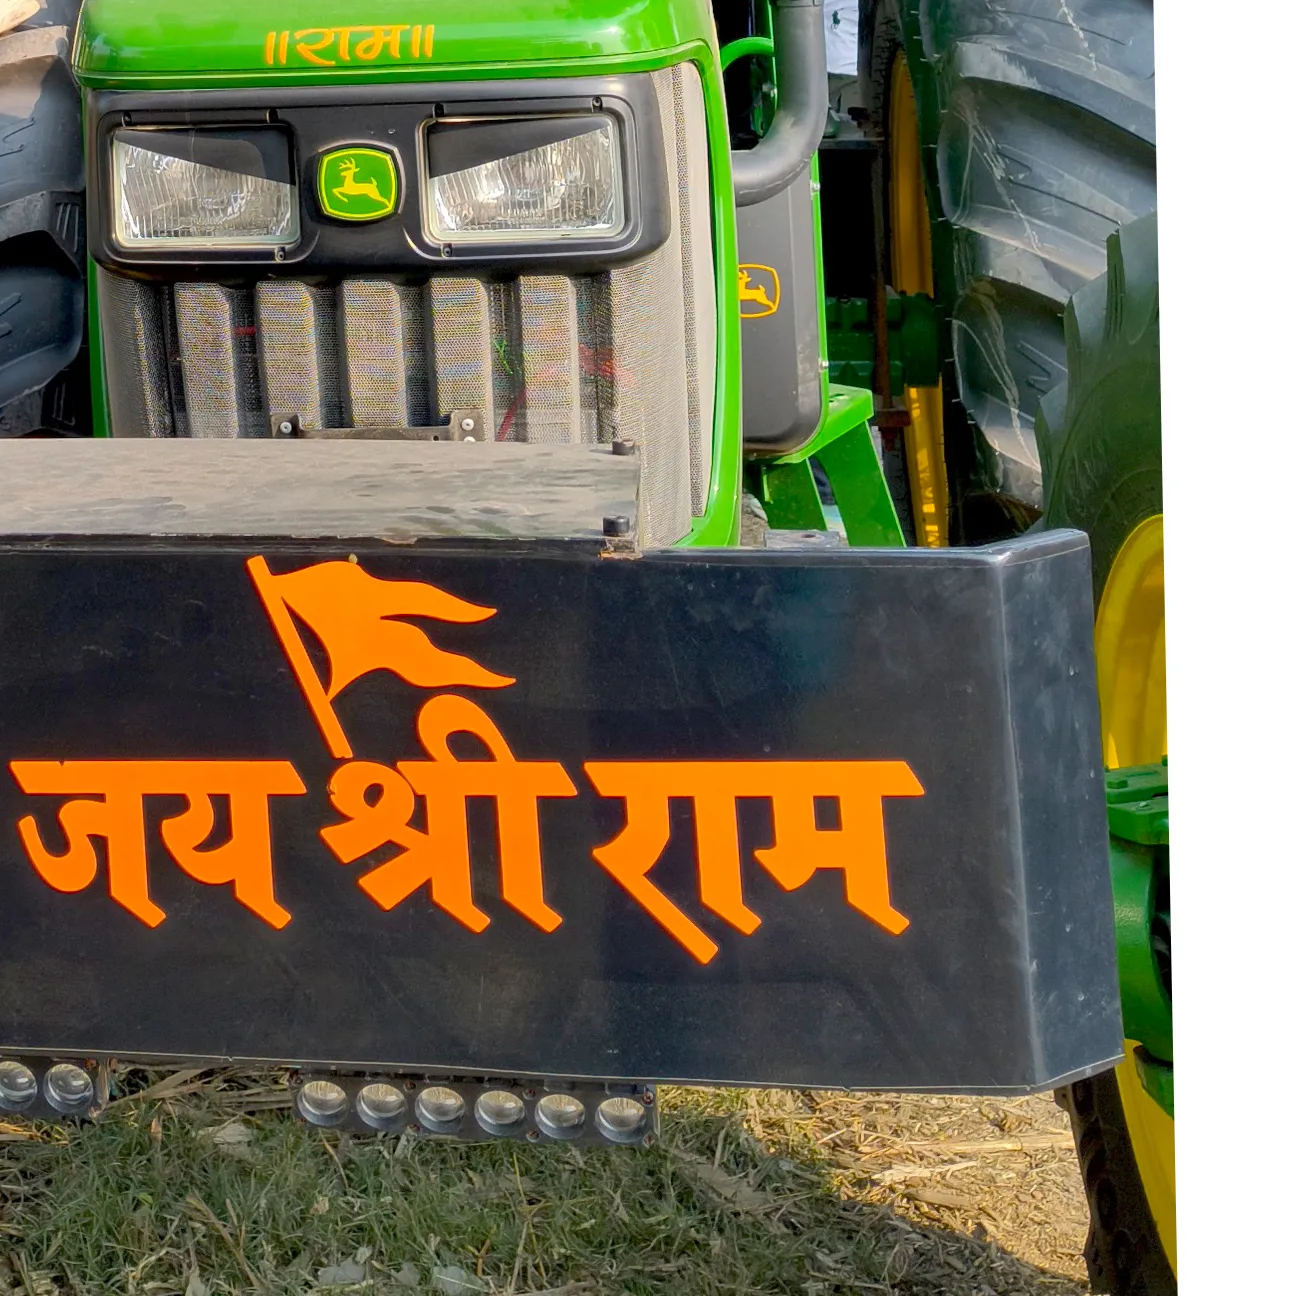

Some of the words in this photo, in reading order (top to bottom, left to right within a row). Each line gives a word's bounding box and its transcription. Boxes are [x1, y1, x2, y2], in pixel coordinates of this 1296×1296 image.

[10, 760, 307, 930] जय
[319, 693, 578, 934] श्री
[583, 760, 925, 965] राम
